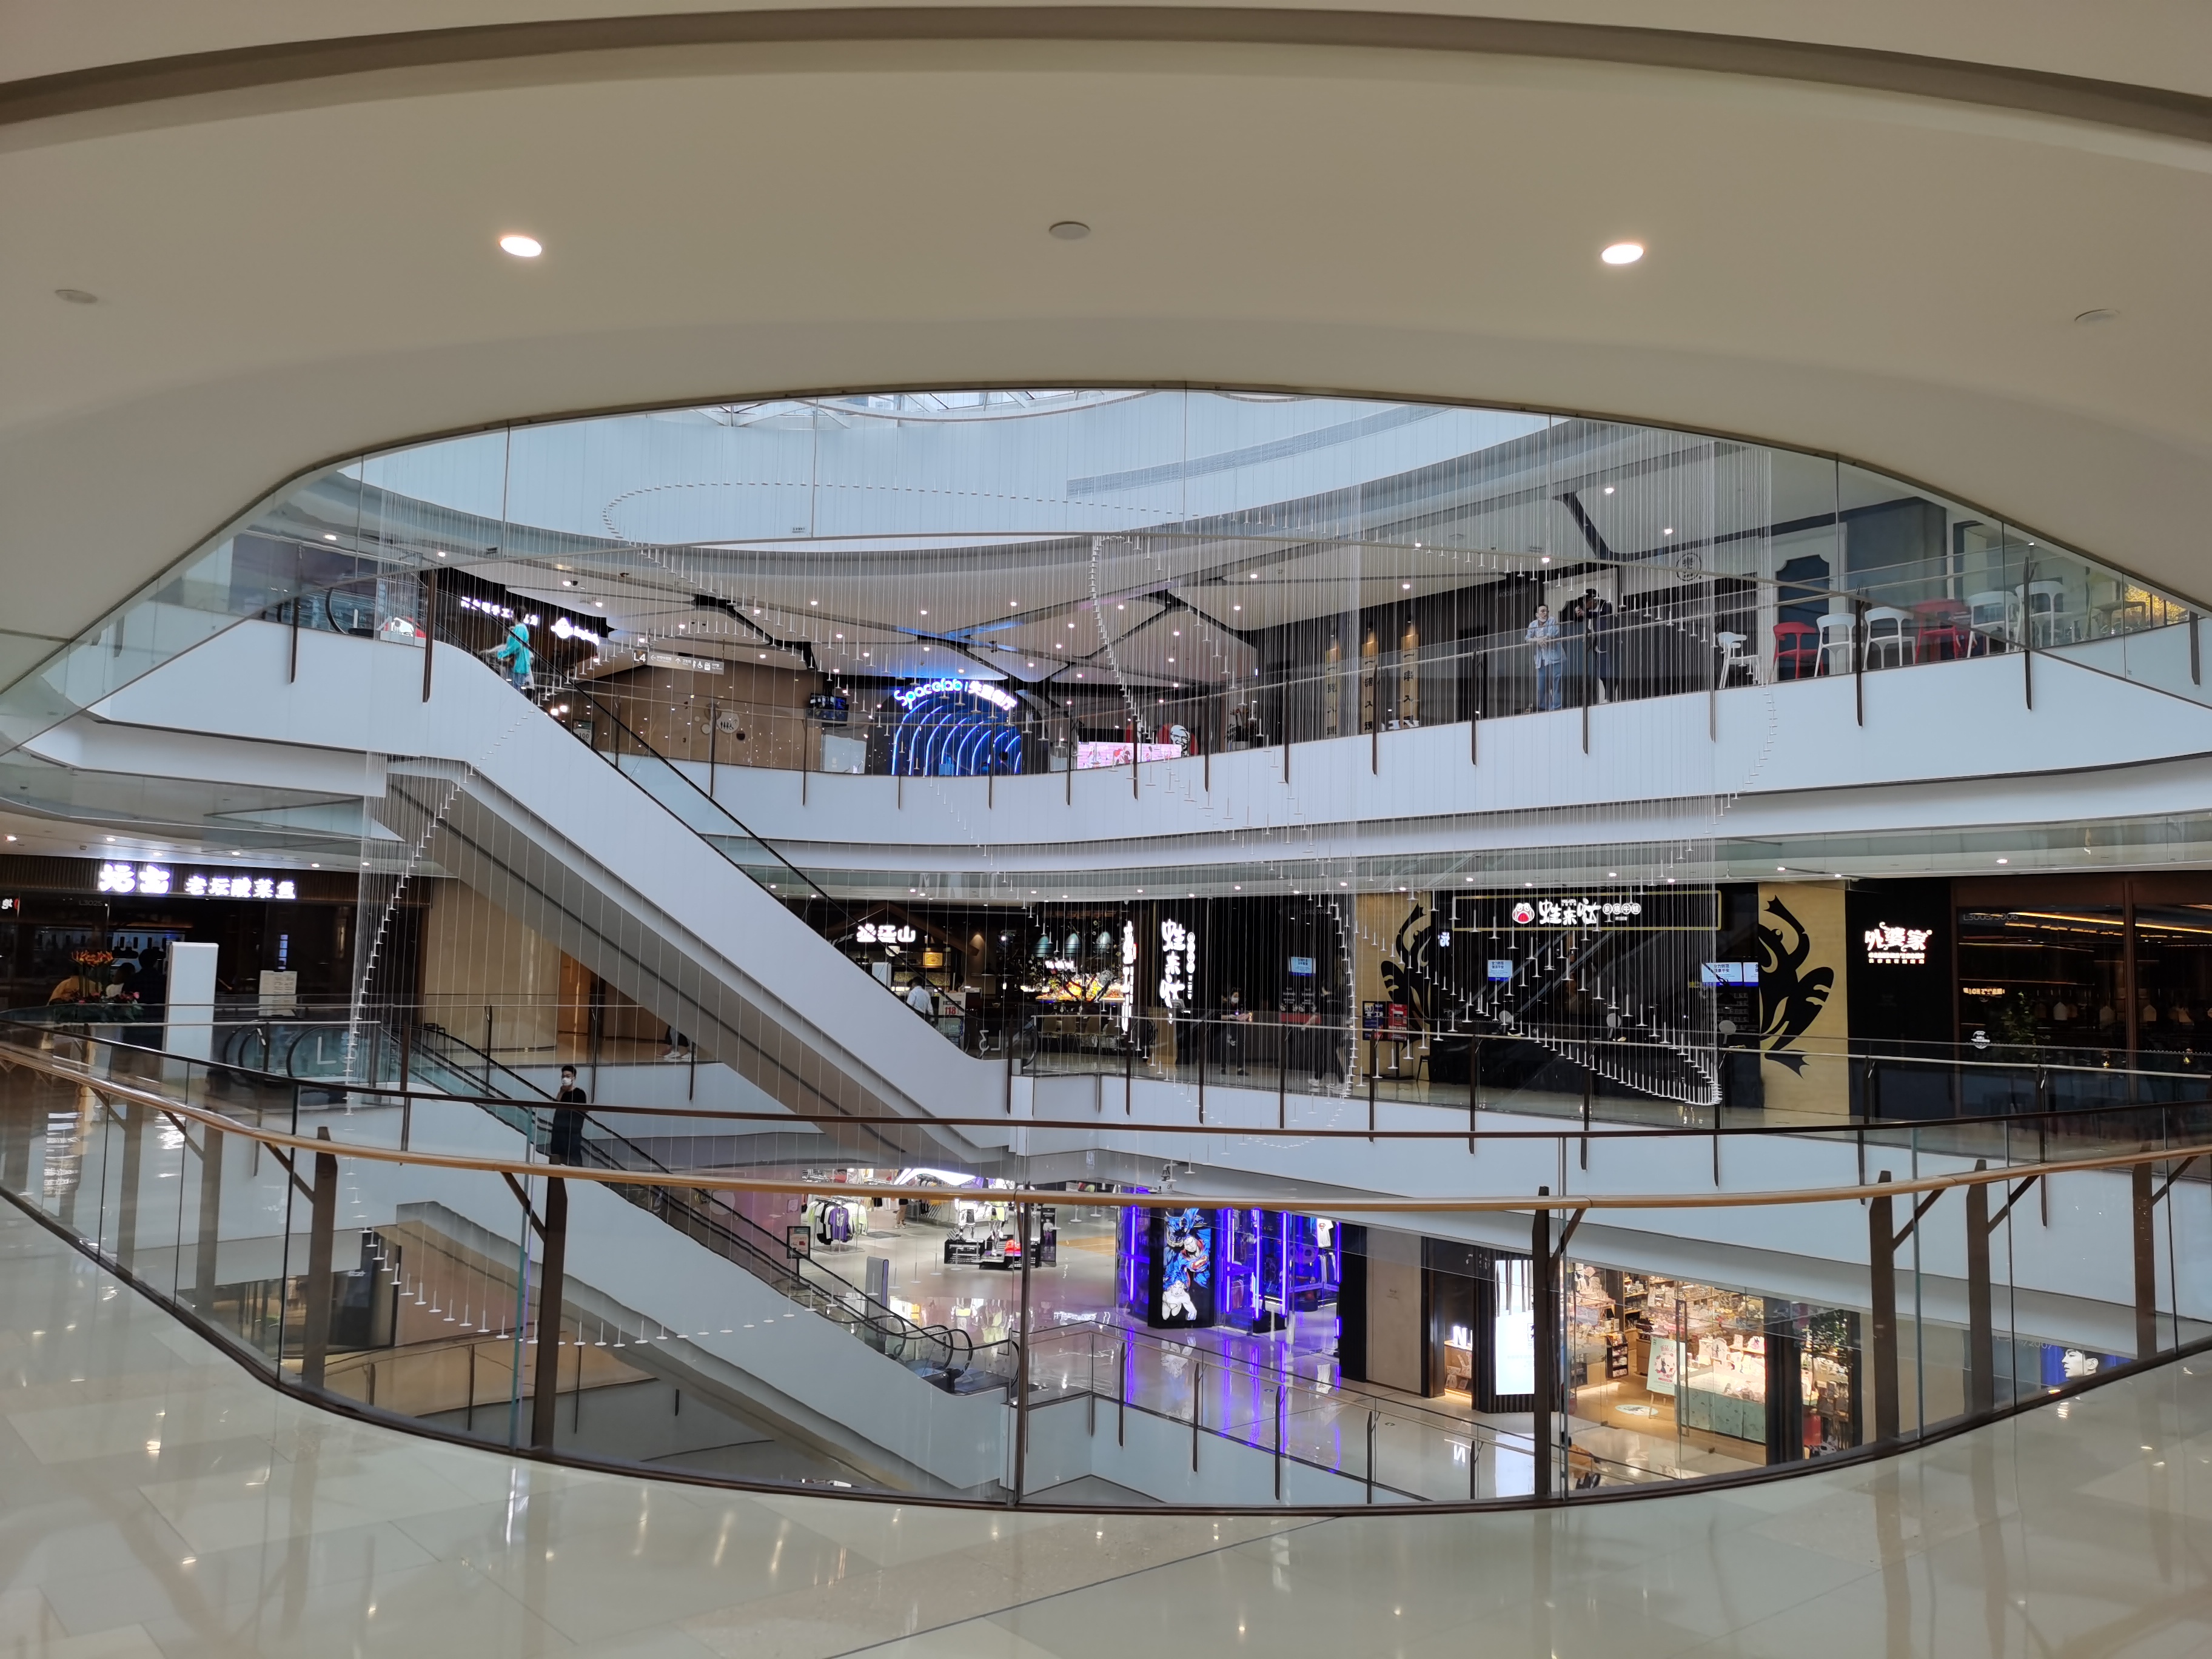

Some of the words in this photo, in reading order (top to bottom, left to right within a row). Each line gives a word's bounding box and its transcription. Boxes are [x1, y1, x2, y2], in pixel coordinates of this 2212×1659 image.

[634, 652, 646, 662] L4
[894, 677, 962, 710] Spacelab
[185, 876, 296, 899] 老坛酸菜鱼
[1539, 898, 1601, 925] 蛙来哒
[1865, 921, 1932, 951] 外婆家
